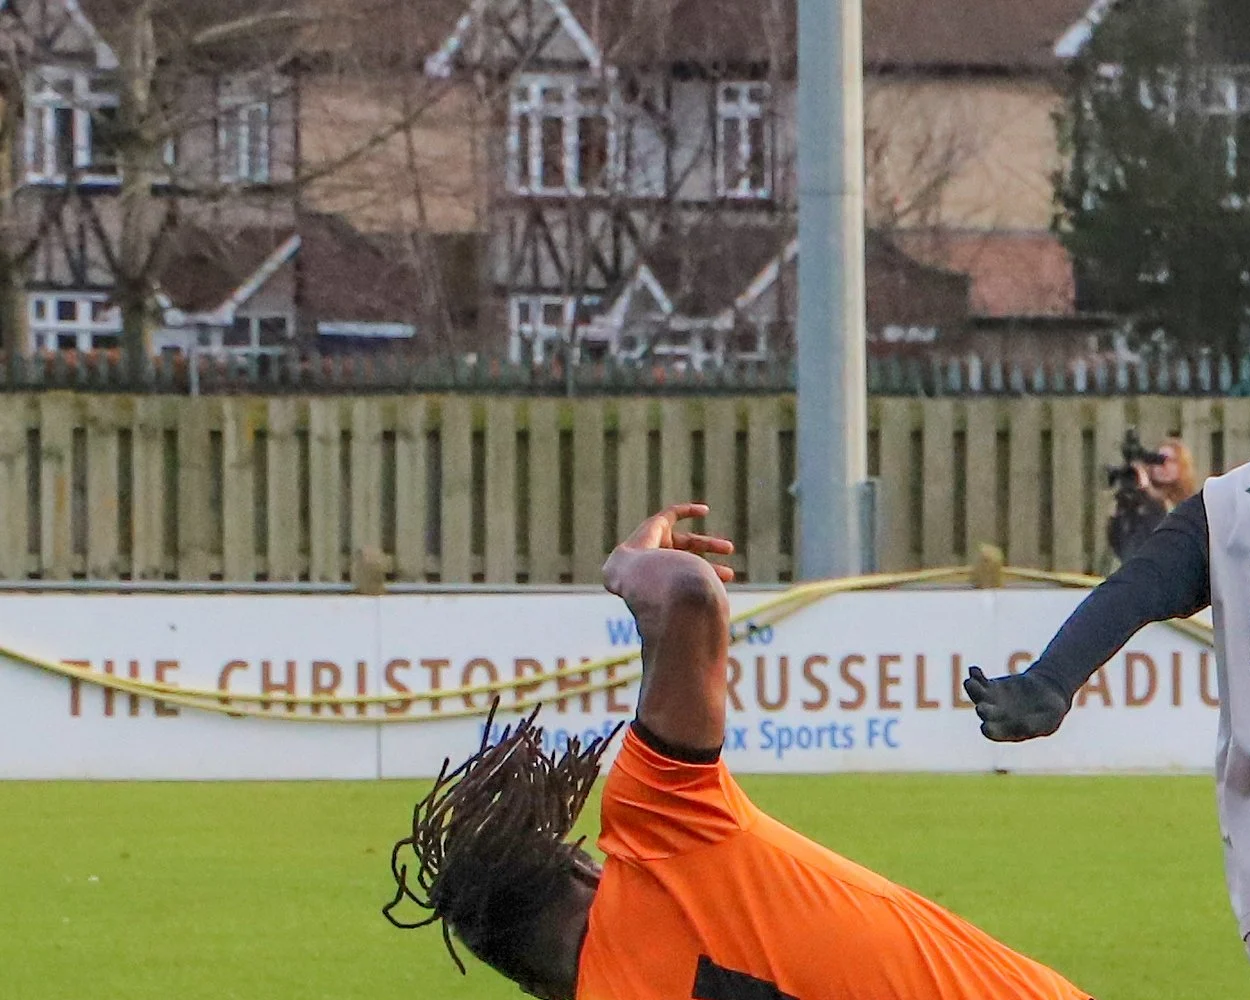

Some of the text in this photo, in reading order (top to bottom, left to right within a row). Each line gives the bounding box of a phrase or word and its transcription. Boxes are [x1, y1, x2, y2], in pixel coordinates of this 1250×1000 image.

[61, 658, 180, 717] THE
[217, 656, 631, 718] CHRISTOPHE
[760, 719, 855, 759] Sports
[866, 717, 899, 749] FC
